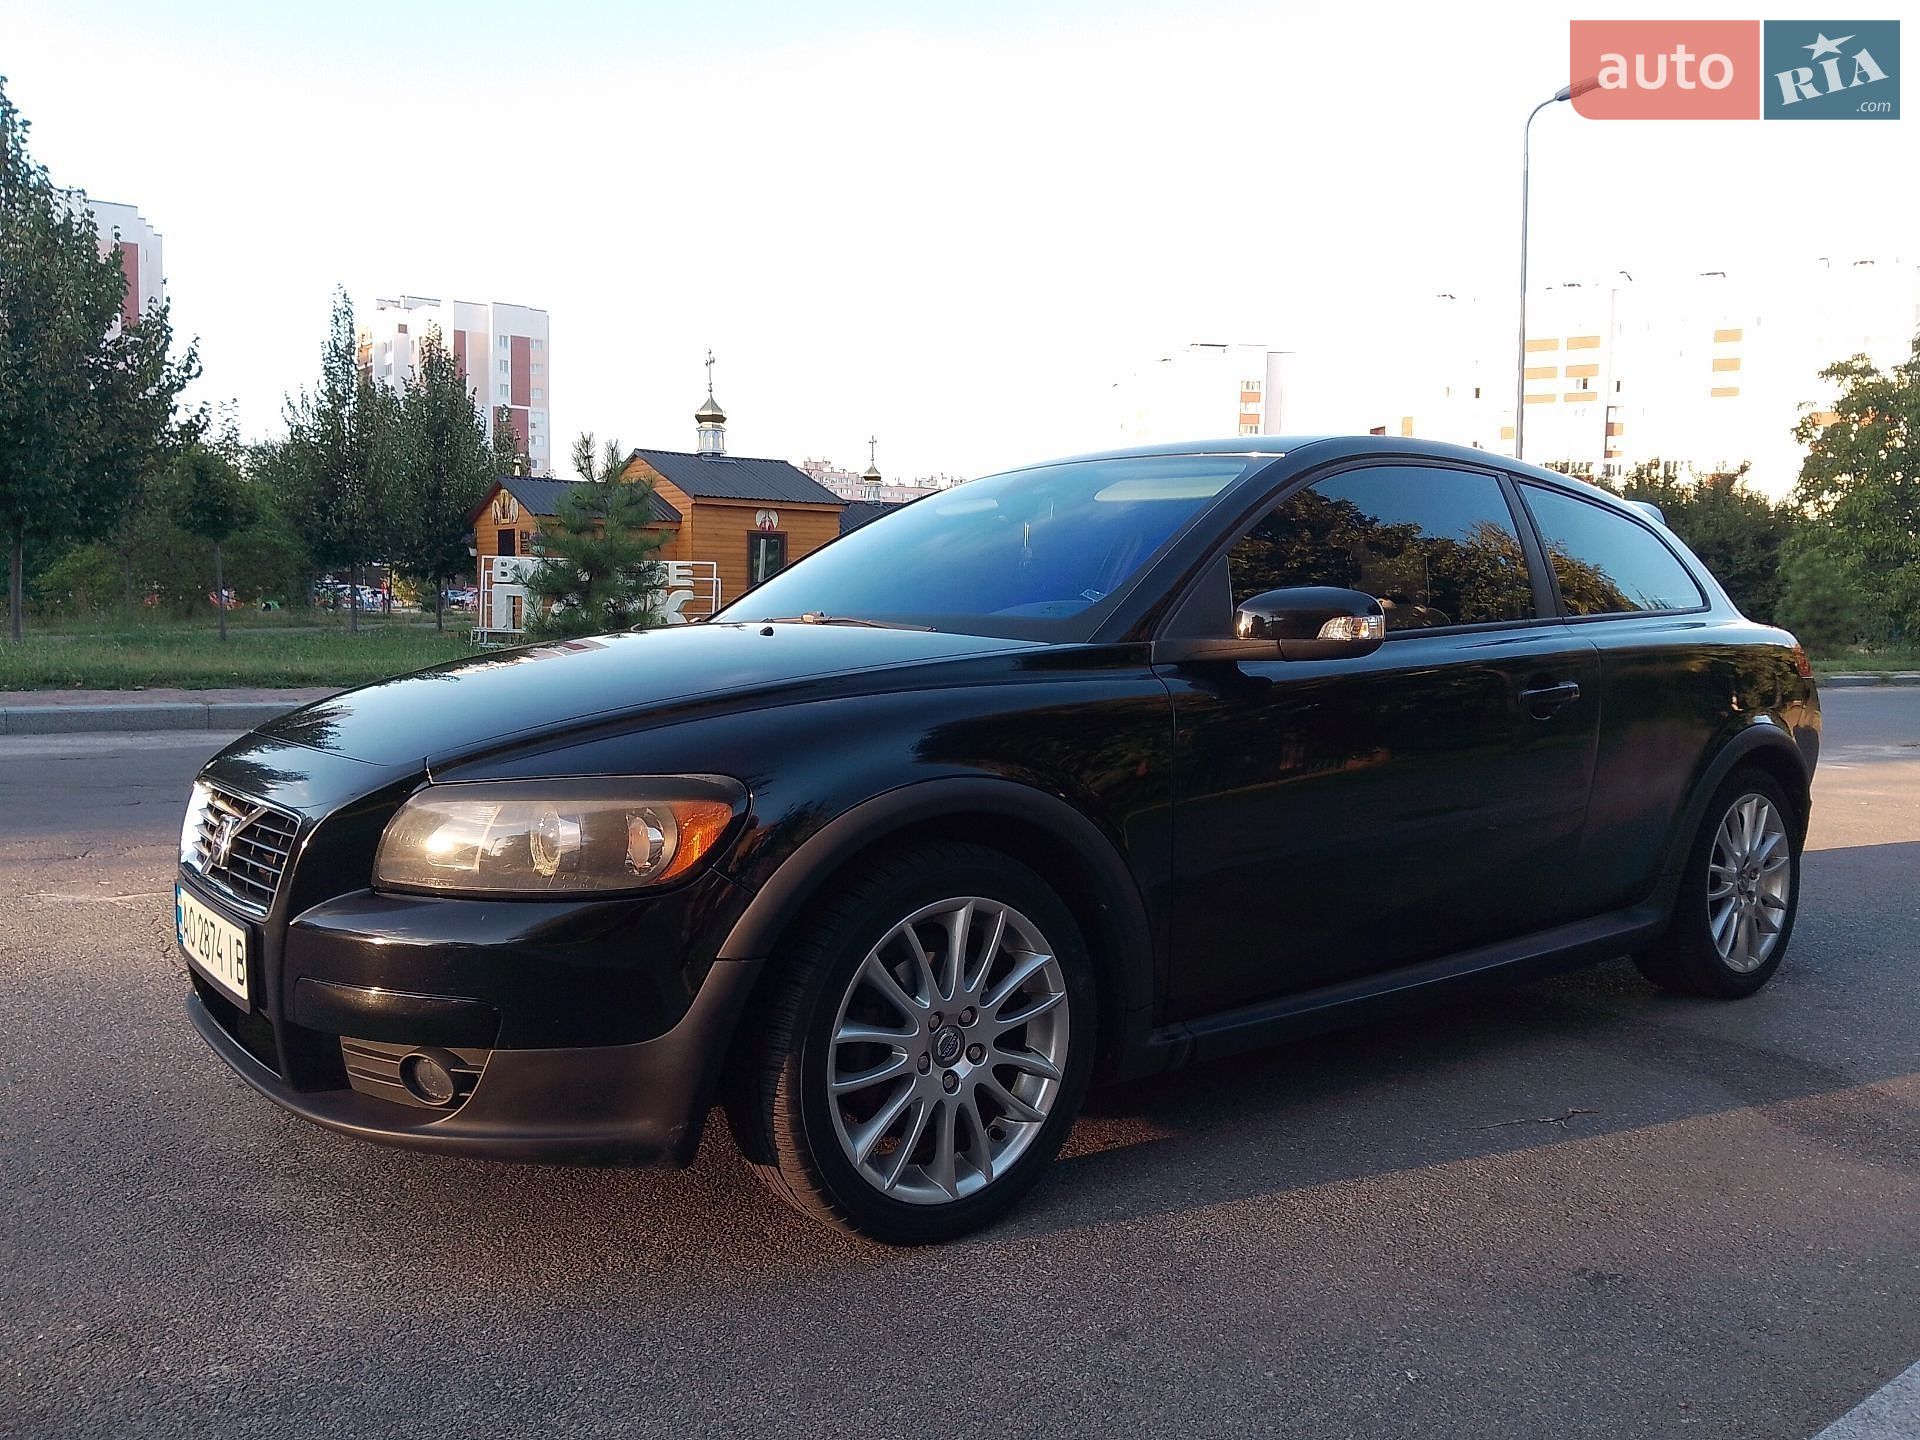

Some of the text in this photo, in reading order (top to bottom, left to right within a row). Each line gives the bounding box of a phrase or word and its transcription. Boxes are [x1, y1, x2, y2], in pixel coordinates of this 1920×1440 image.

[183, 901, 246, 986] AO 2874 IB
